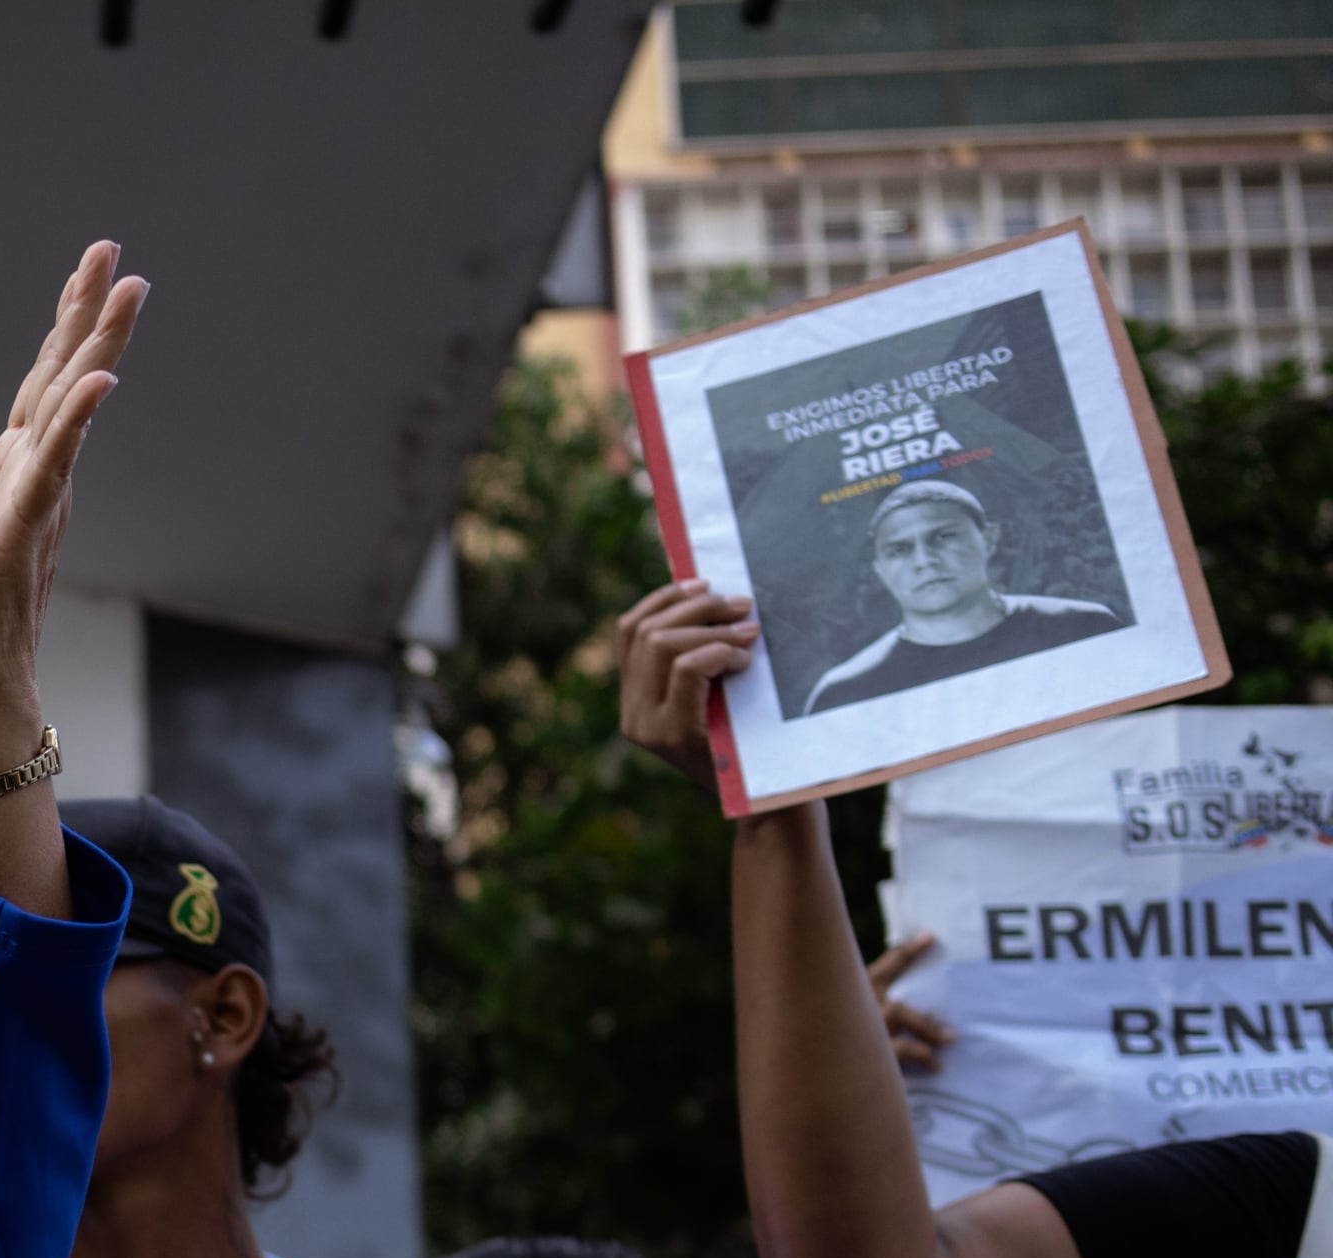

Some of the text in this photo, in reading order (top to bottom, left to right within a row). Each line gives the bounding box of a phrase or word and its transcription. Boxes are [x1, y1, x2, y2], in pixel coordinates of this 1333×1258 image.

[891, 346, 1015, 395] LIBERTAD
[784, 369, 999, 444] INMEDIATA PARA
[840, 402, 940, 456] JOSÉ
[841, 430, 964, 482] RIERA
[1113, 760, 1246, 794] Familia
[985, 898, 1333, 962] ERMILEN
[1110, 1002, 1333, 1057] BENIT
